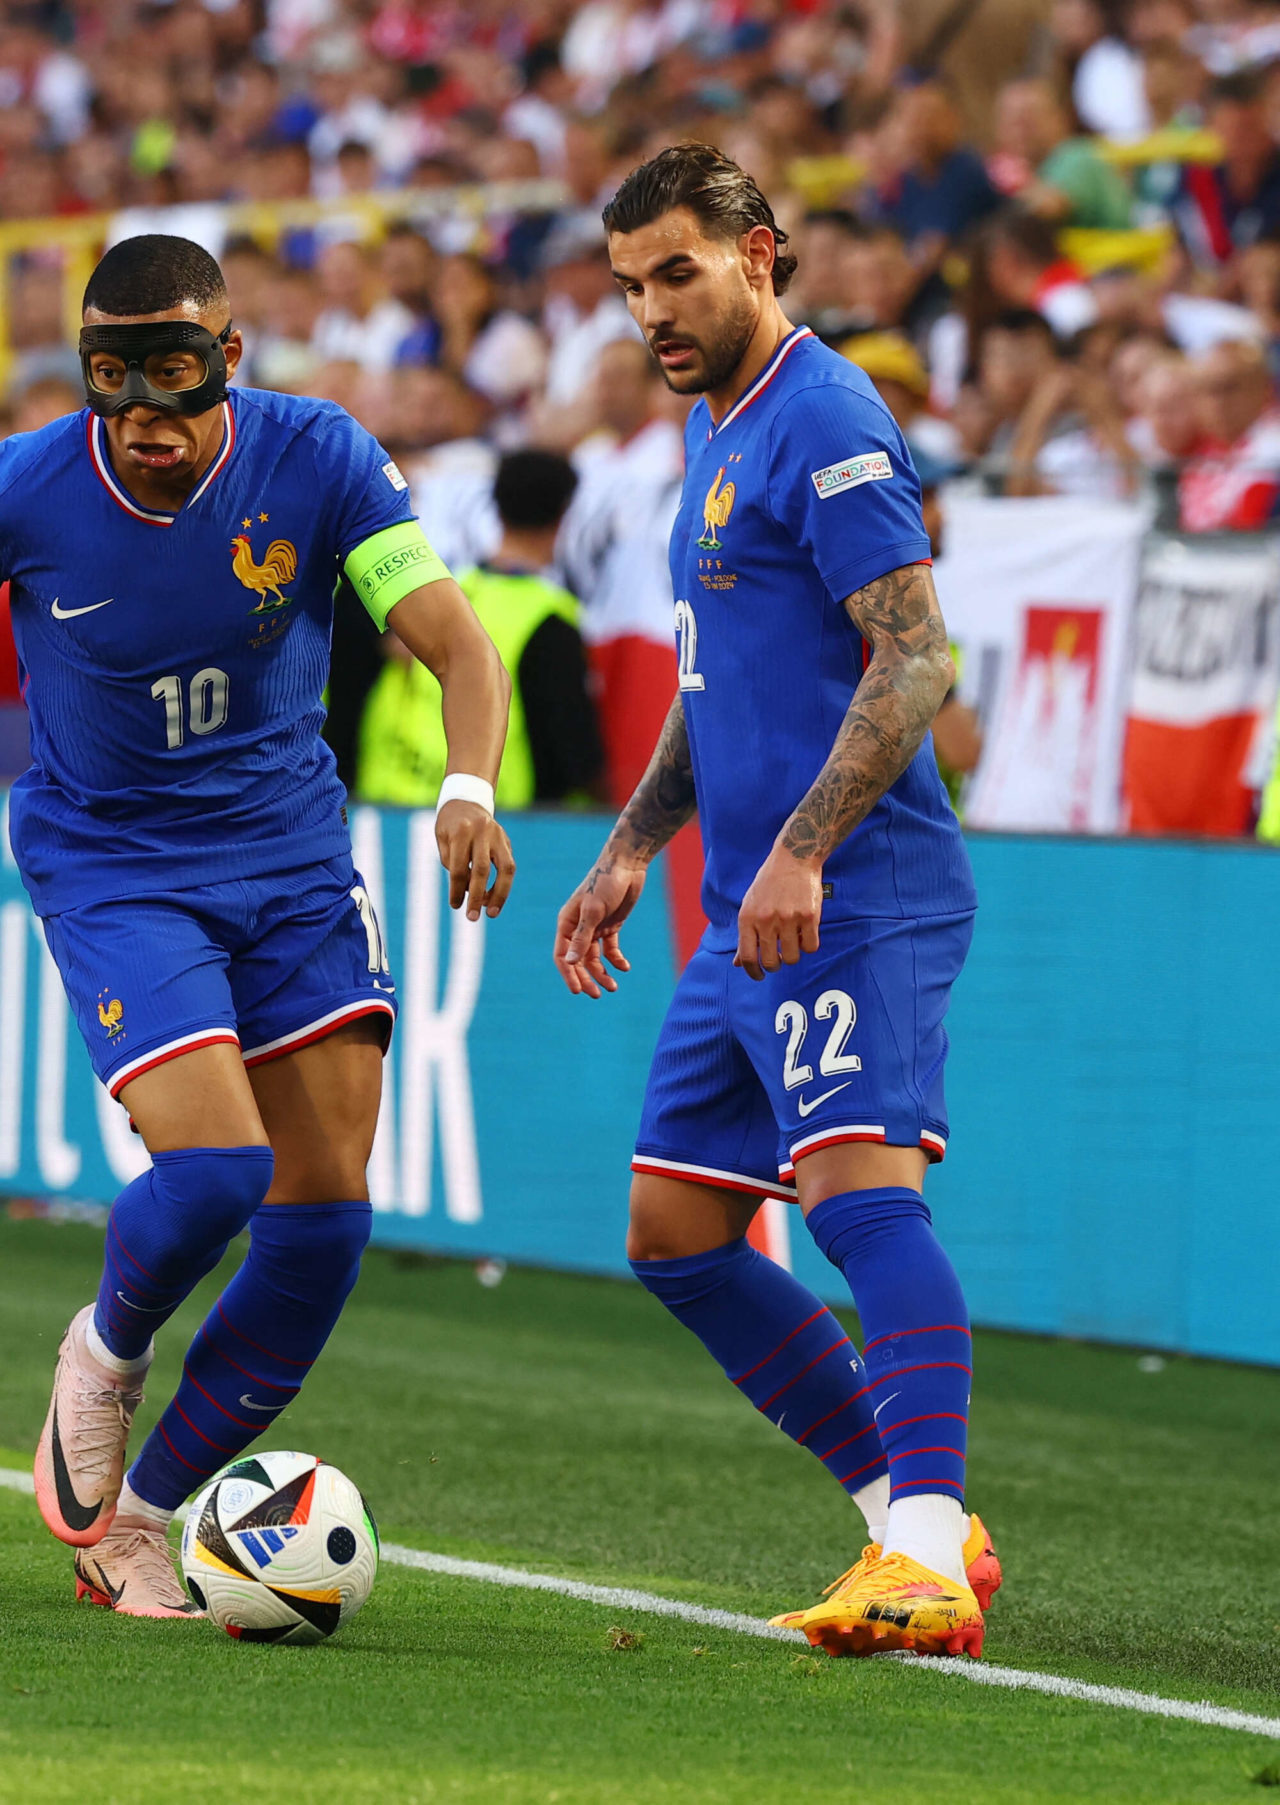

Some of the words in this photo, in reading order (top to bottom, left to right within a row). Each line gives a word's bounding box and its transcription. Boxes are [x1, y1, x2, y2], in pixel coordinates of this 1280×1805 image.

[816, 460, 889, 490] FOUNDATION
[375, 545, 432, 580] RESPEC
[151, 667, 230, 751] 10
[775, 989, 862, 1091] 22
